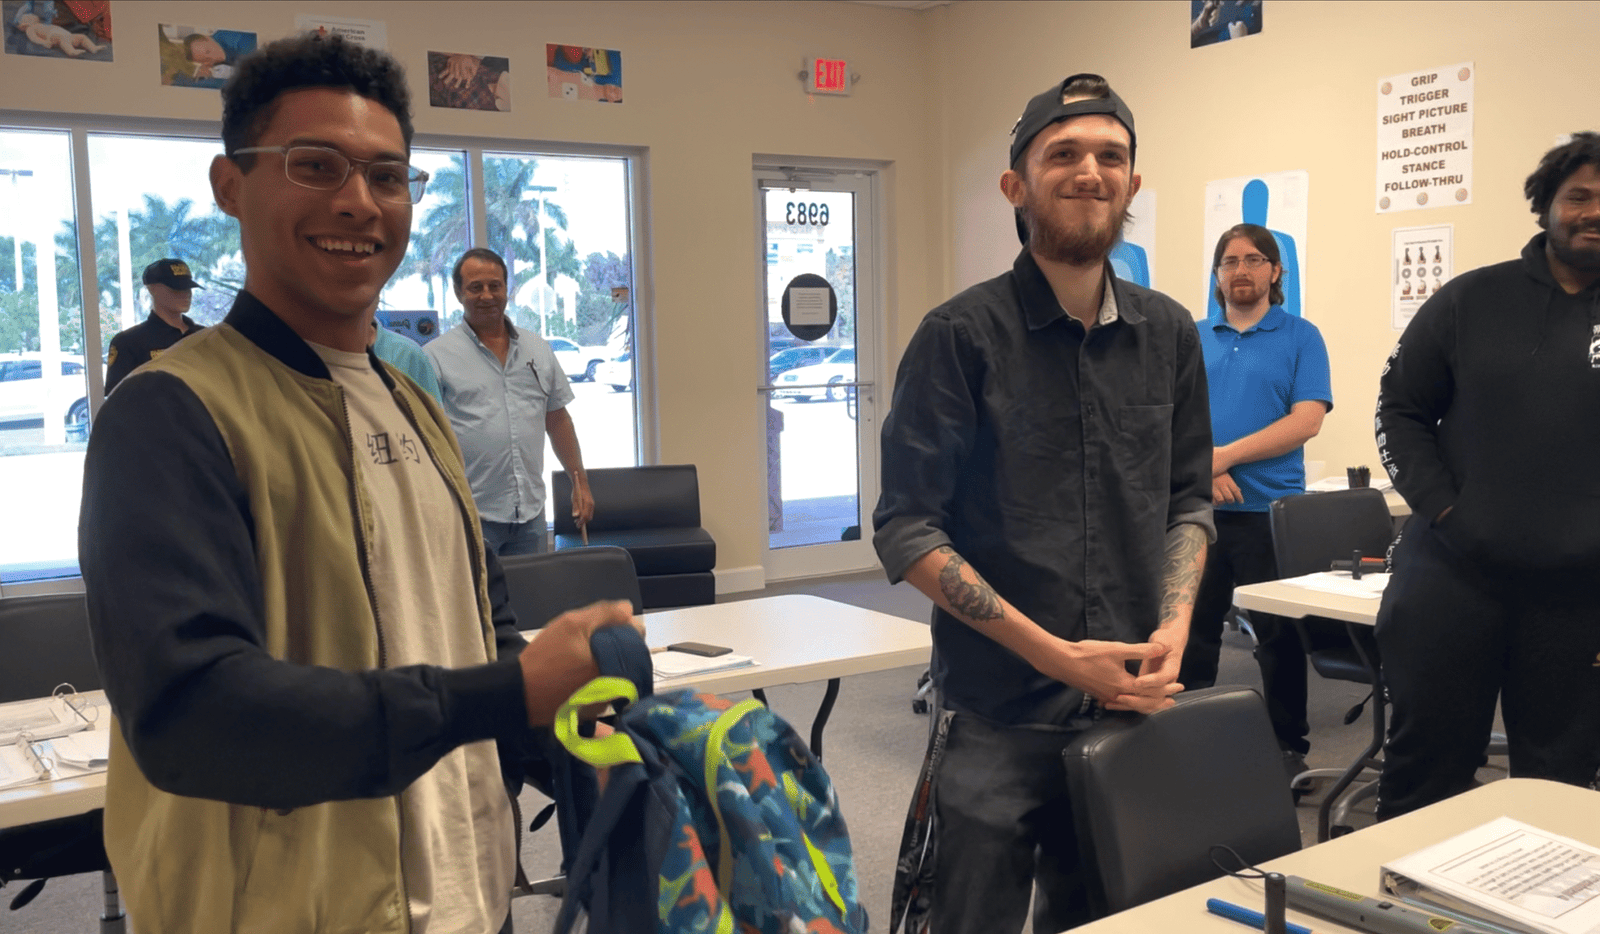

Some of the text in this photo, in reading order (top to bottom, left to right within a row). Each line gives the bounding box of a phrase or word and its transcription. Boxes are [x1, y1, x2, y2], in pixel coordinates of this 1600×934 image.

[331, 26, 365, 34] American
[815, 58, 846, 91] EXIT
[1411, 73, 1438, 87] GRIP
[1400, 88, 1449, 105] TRIGGER
[1382, 102, 1468, 125] SIGHT PICTURE
[1402, 123, 1446, 139] BREATH
[1381, 140, 1468, 160] HOLD-CONTROL
[1402, 160, 1446, 174] STANCE
[1384, 174, 1463, 191] FOLLOW-THRU
[366, 431, 421, 465] 纽约
